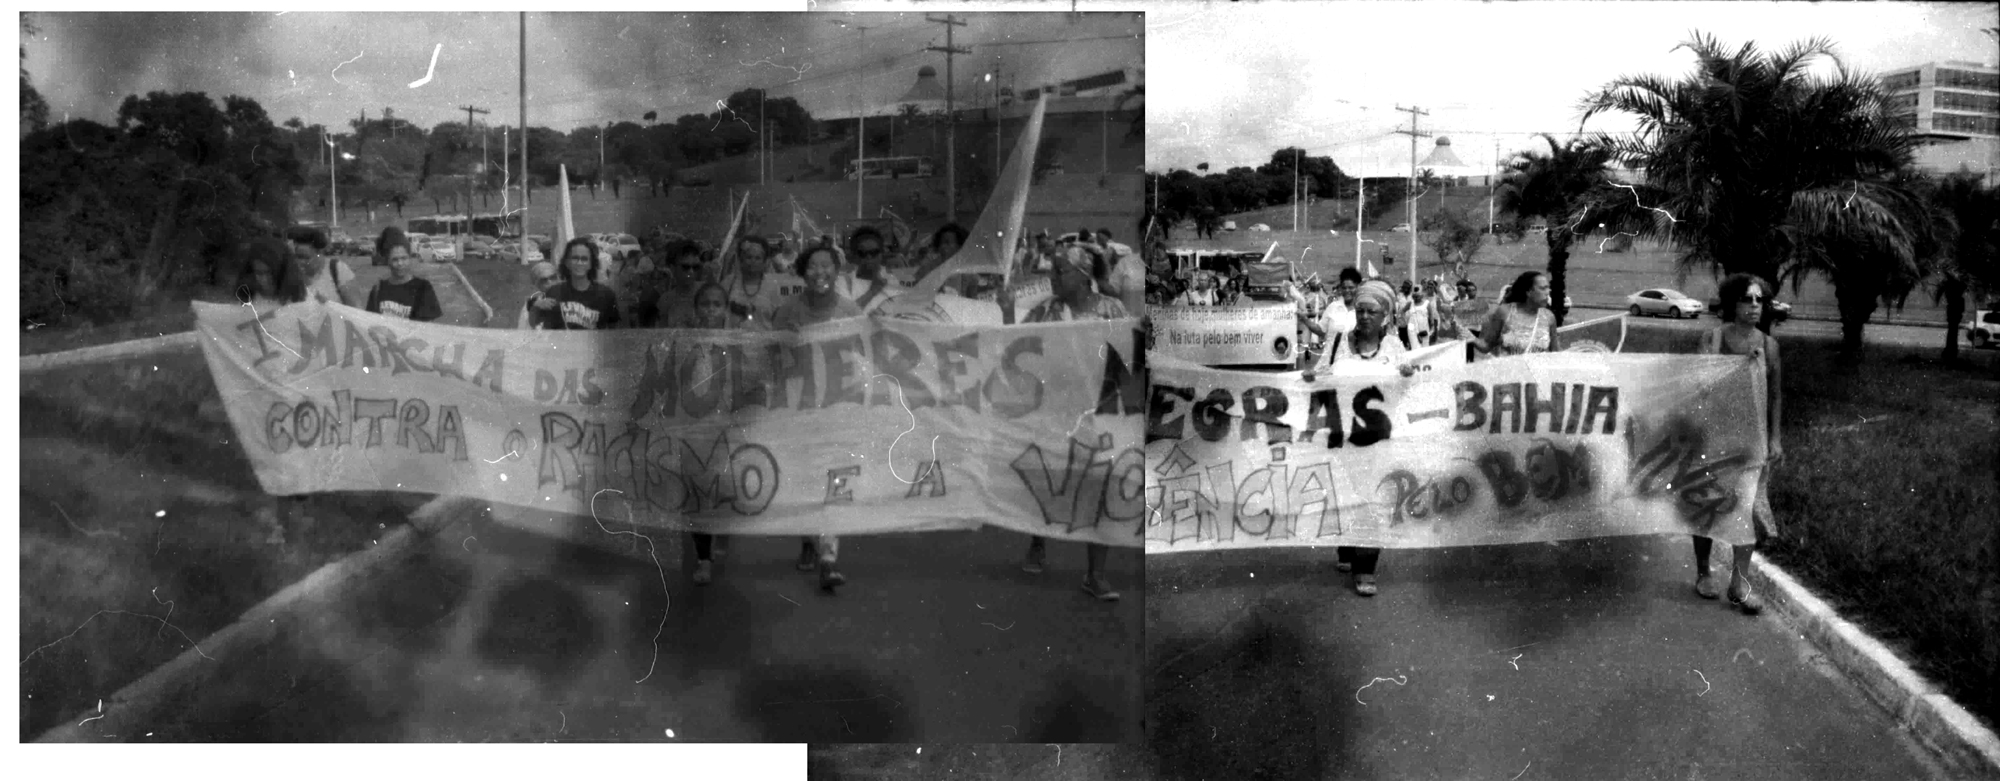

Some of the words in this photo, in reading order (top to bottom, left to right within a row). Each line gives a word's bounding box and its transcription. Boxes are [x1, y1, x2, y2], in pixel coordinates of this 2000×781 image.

[285, 312, 506, 396] MARCHA
[533, 368, 602, 406] DAS
[631, 328, 1044, 420] MULHERES
[1454, 382, 1620, 435] BAHIA
[1169, 329, 1182, 345] Na
[1184, 329, 1201, 345] luta
[1203, 328, 1221, 349] pelo
[1223, 329, 1242, 346] bem
[1243, 329, 1264, 345] viver
[265, 389, 468, 462] CONTRA
[538, 410, 781, 515] RACISMO
[824, 465, 861, 504] E
[904, 460, 947, 500] A
